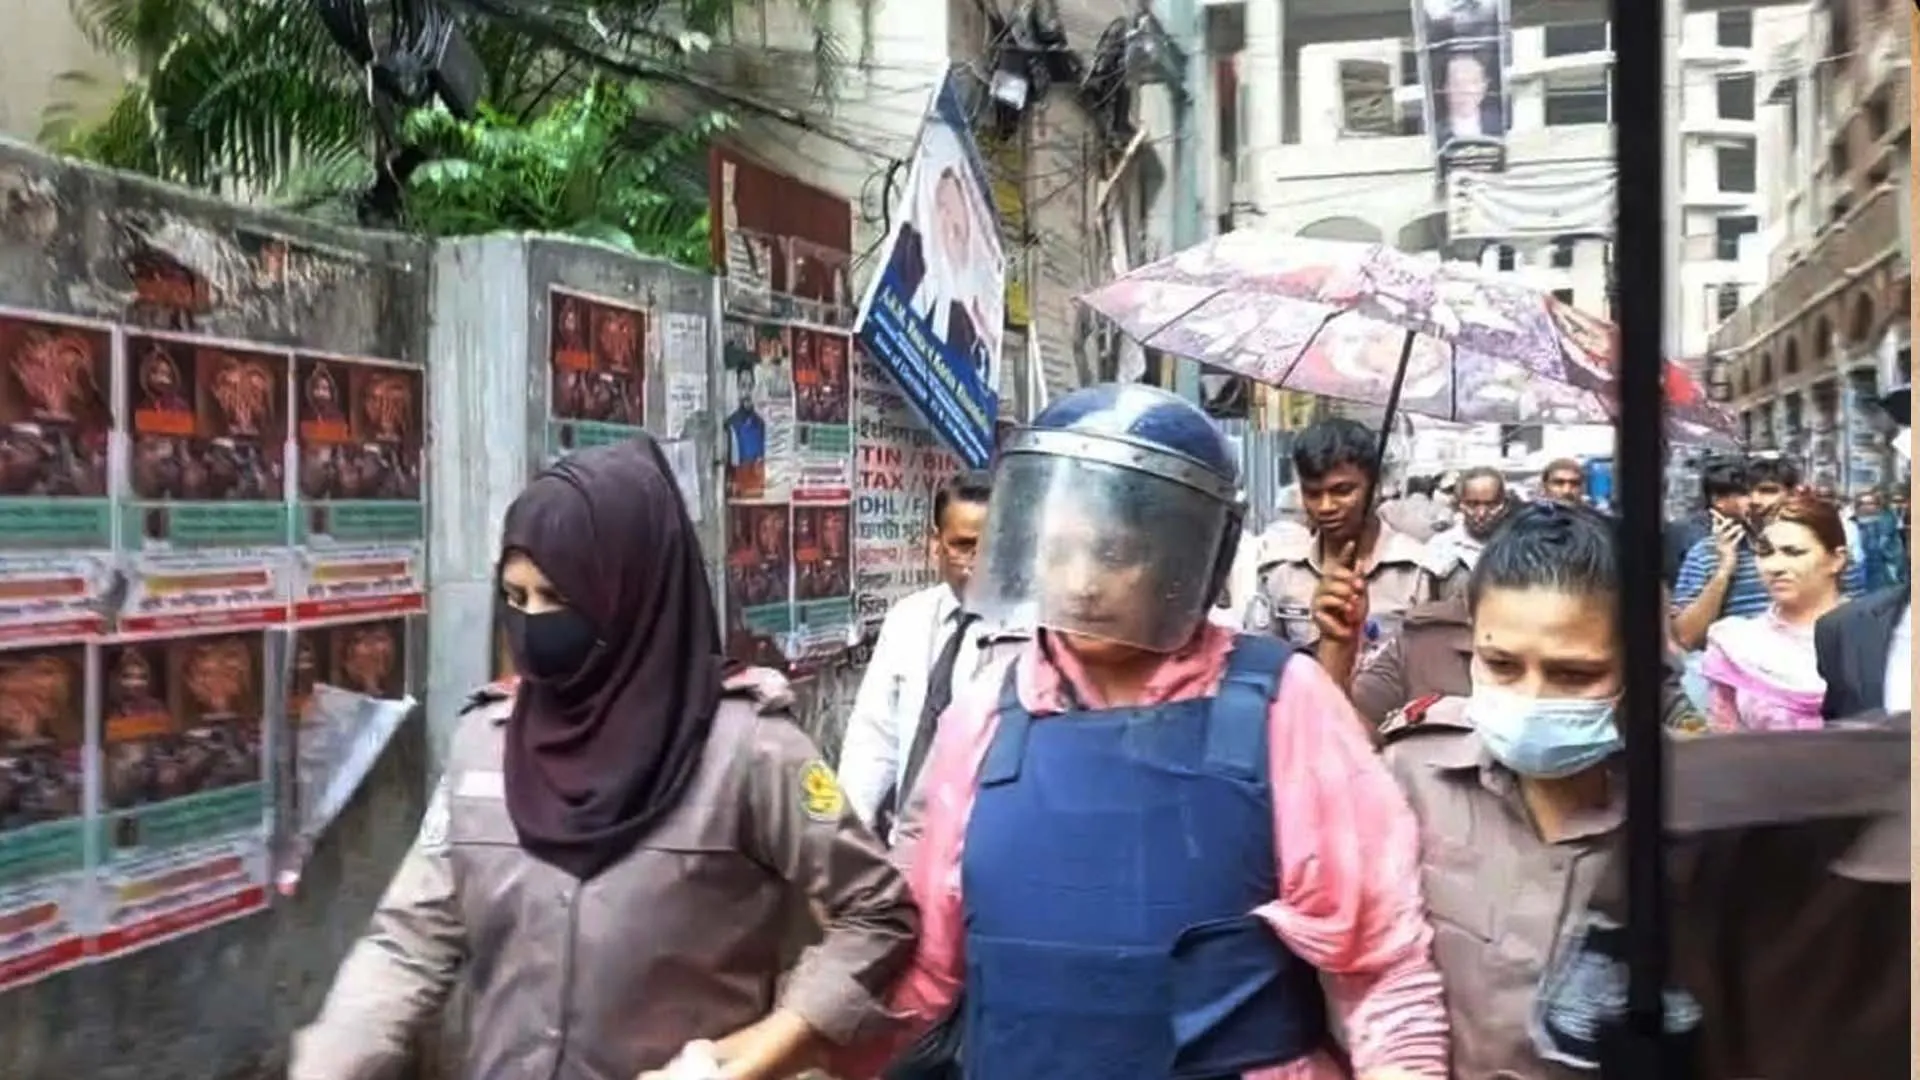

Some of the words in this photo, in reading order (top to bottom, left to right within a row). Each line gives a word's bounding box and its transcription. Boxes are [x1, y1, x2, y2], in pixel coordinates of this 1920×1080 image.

[859, 444, 902, 466] TIN
[859, 471, 905, 491] TAX
[859, 495, 900, 515] DHL
